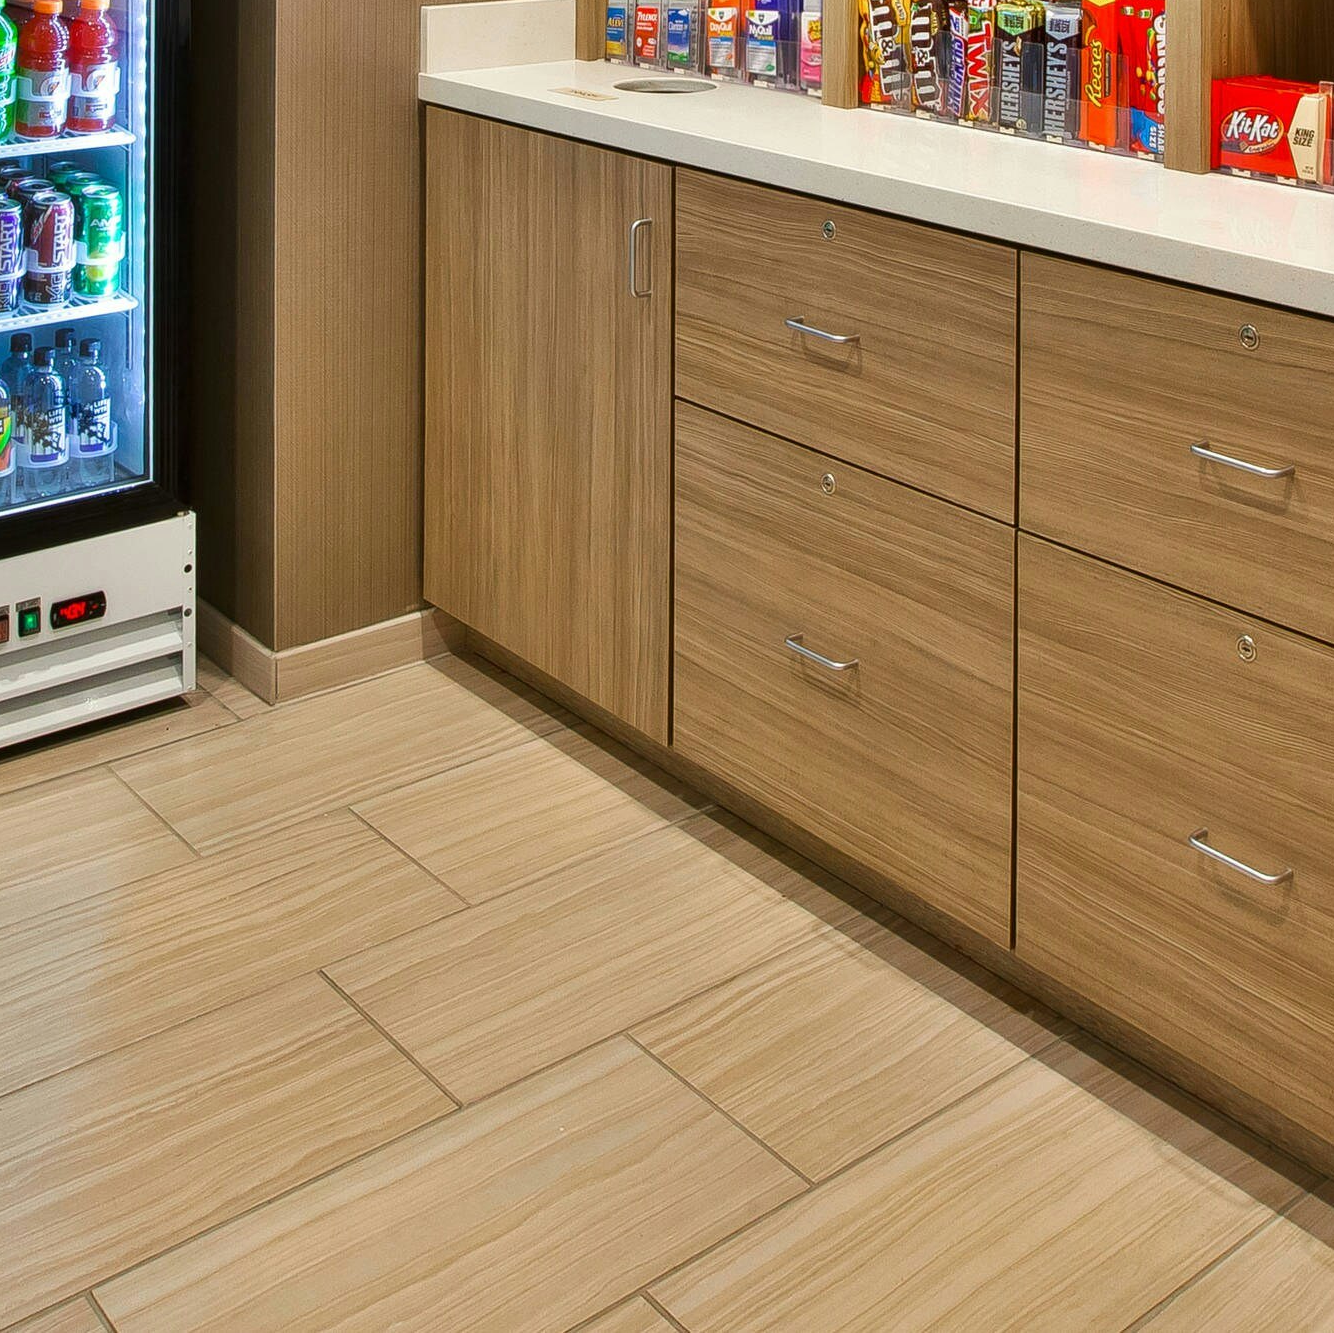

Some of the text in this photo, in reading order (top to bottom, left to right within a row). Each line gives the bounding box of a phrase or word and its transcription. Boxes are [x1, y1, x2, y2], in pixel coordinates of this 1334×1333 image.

[968, 21, 993, 118] TWIX
[1084, 39, 1104, 108] Reese's
[1001, 40, 1021, 122] HERSHEY'S
[1044, 41, 1068, 136] HERSHEY'S
[1149, 126, 1158, 149] SIZE
[1294, 127, 1315, 139] KING
[1292, 137, 1313, 148] SIZE
[93, 398, 110, 408] LIFE
[48, 409, 64, 418] LIFE
[93, 406, 109, 416] WTR
[48, 415, 64, 425] WTR
